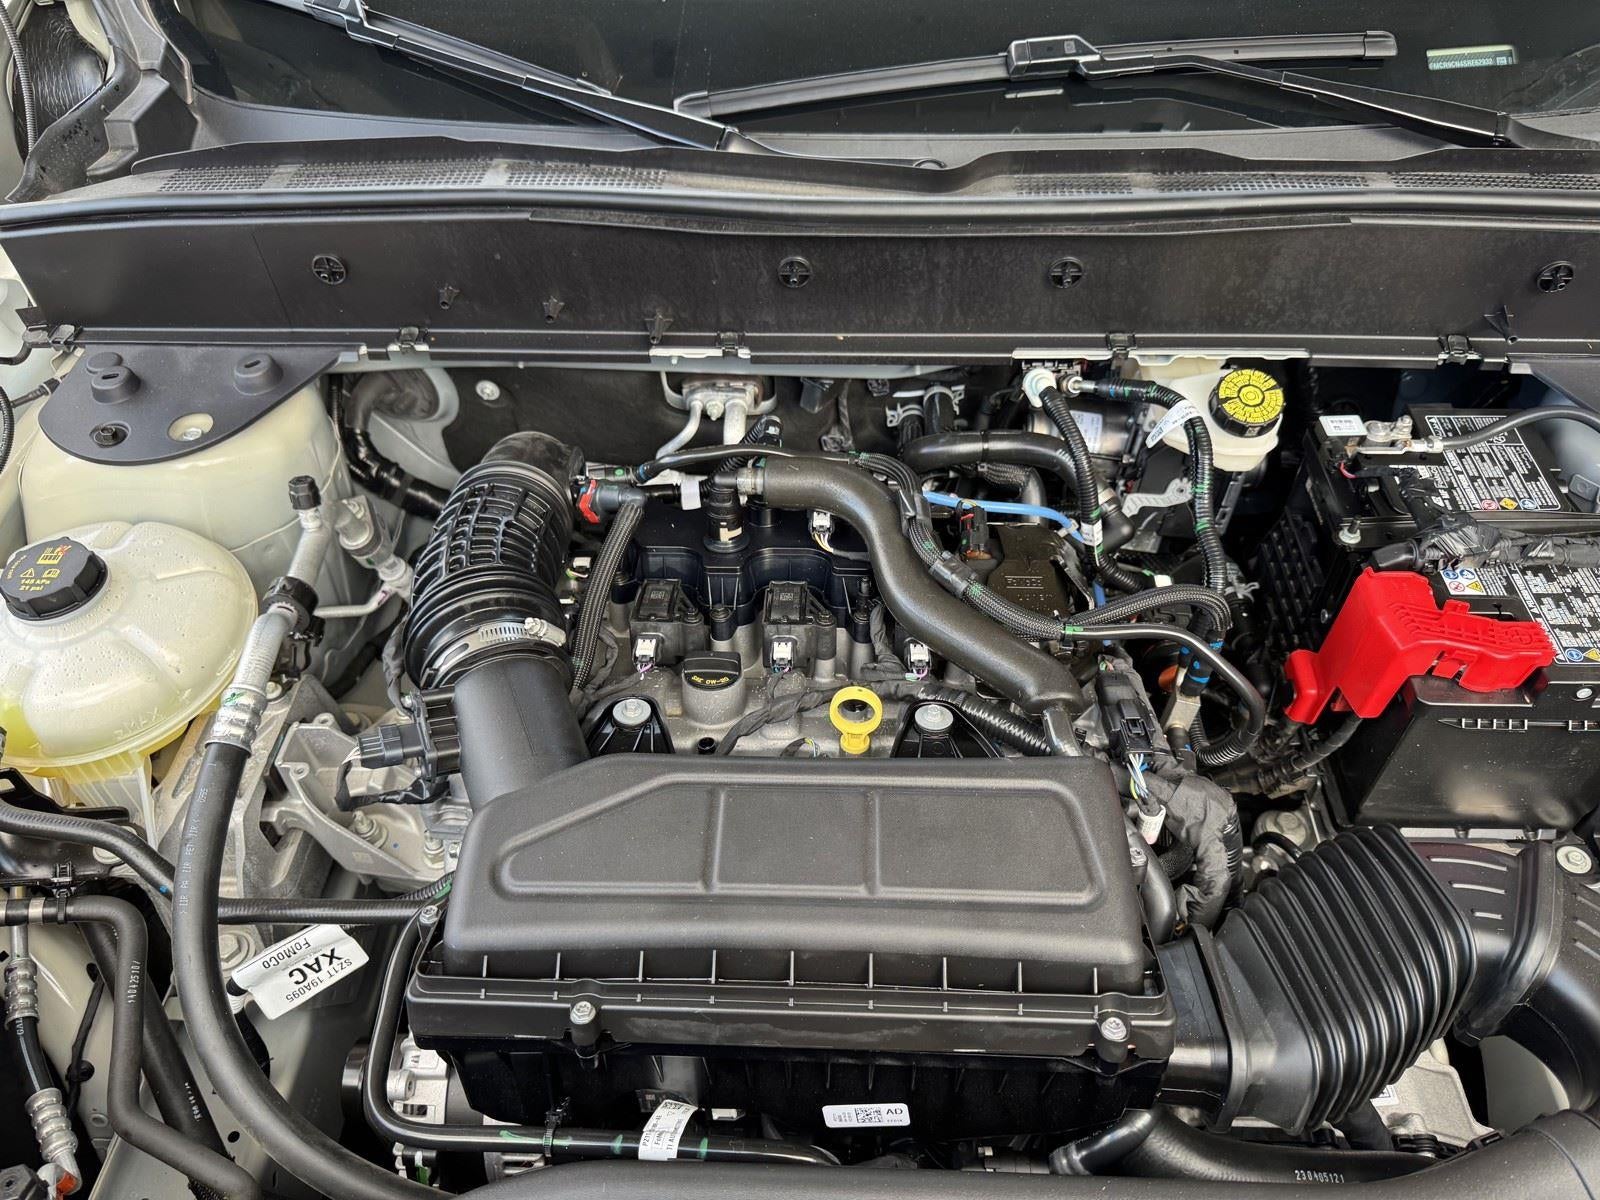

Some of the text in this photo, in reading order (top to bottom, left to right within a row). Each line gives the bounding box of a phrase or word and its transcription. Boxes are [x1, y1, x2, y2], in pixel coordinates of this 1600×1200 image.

[262, 937, 312, 969] FoMoCo
[288, 947, 343, 985] XAC
[285, 976, 323, 1003] 19A095
[16, 1017, 24, 1036] GAL
